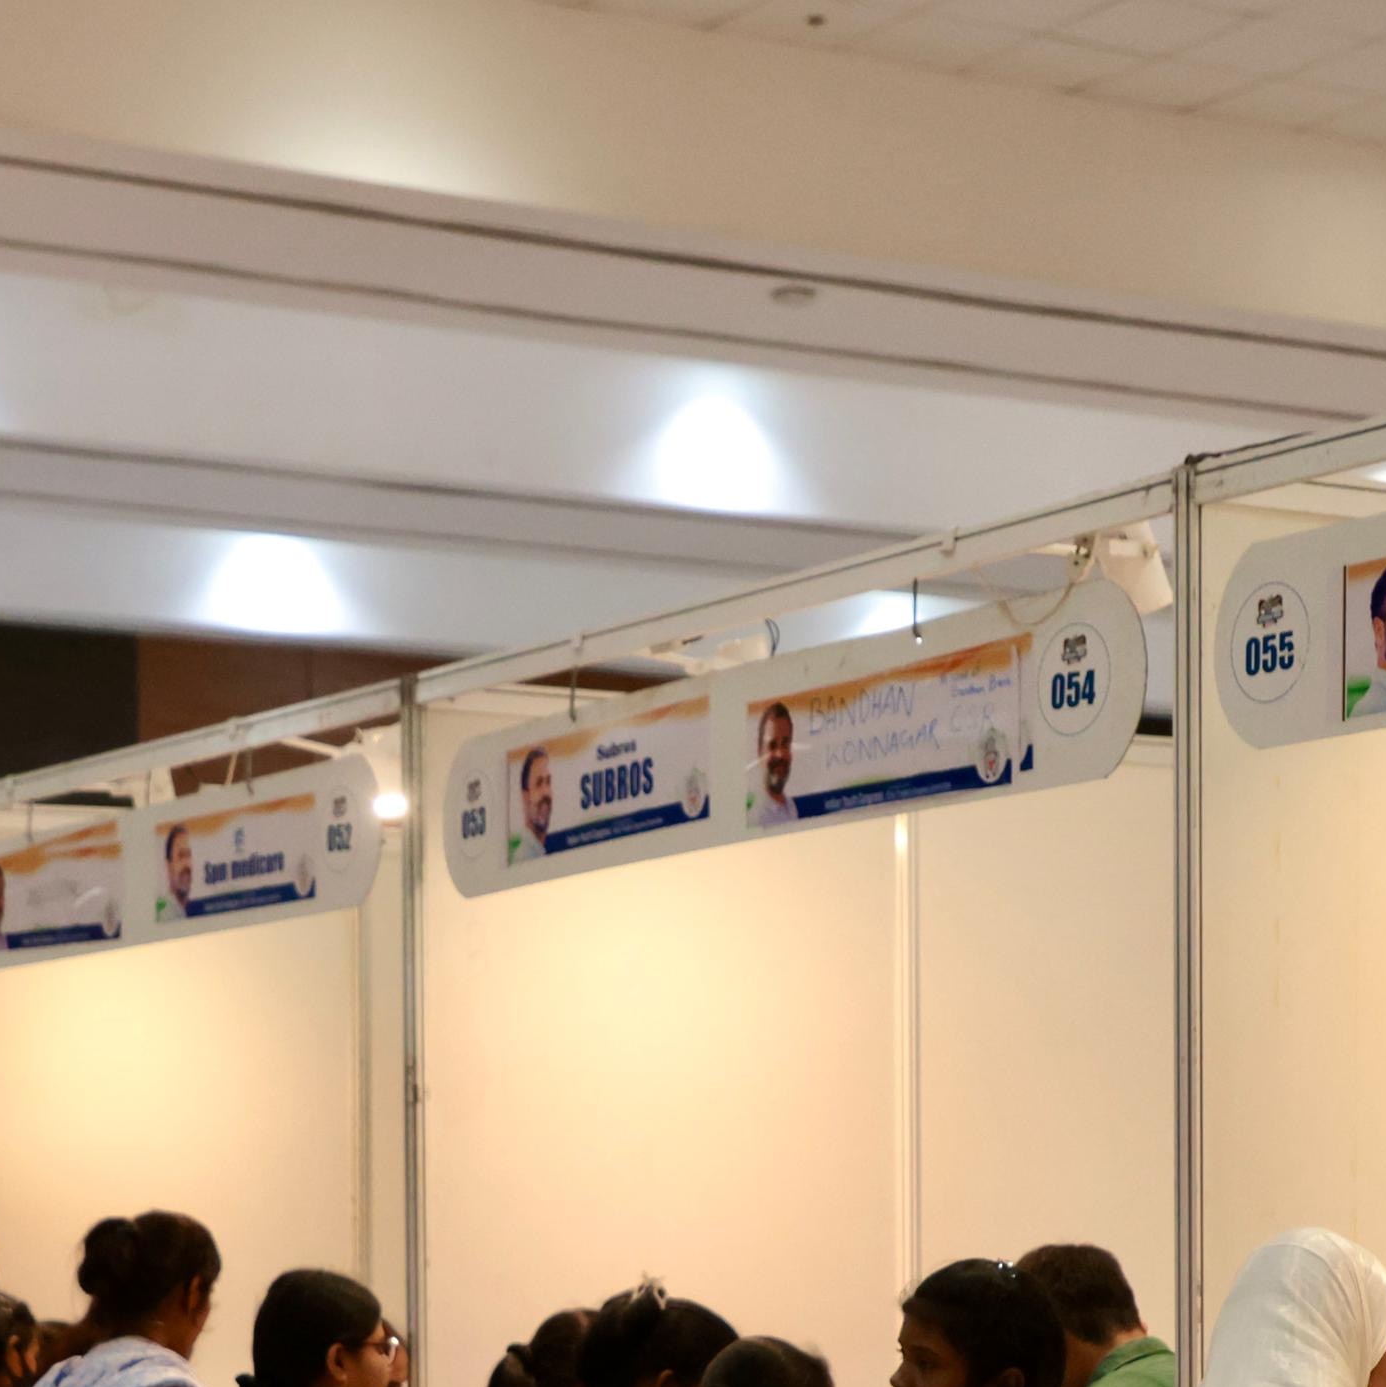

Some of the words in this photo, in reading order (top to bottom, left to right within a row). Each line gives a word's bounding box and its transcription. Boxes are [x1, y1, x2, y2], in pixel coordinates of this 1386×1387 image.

[1245, 630, 1295, 676] 055
[808, 684, 914, 736] BANDHAN
[1051, 669, 1096, 710] 054
[580, 757, 654, 810] SUBROS
[327, 822, 352, 852] 052
[461, 806, 486, 839] 053
